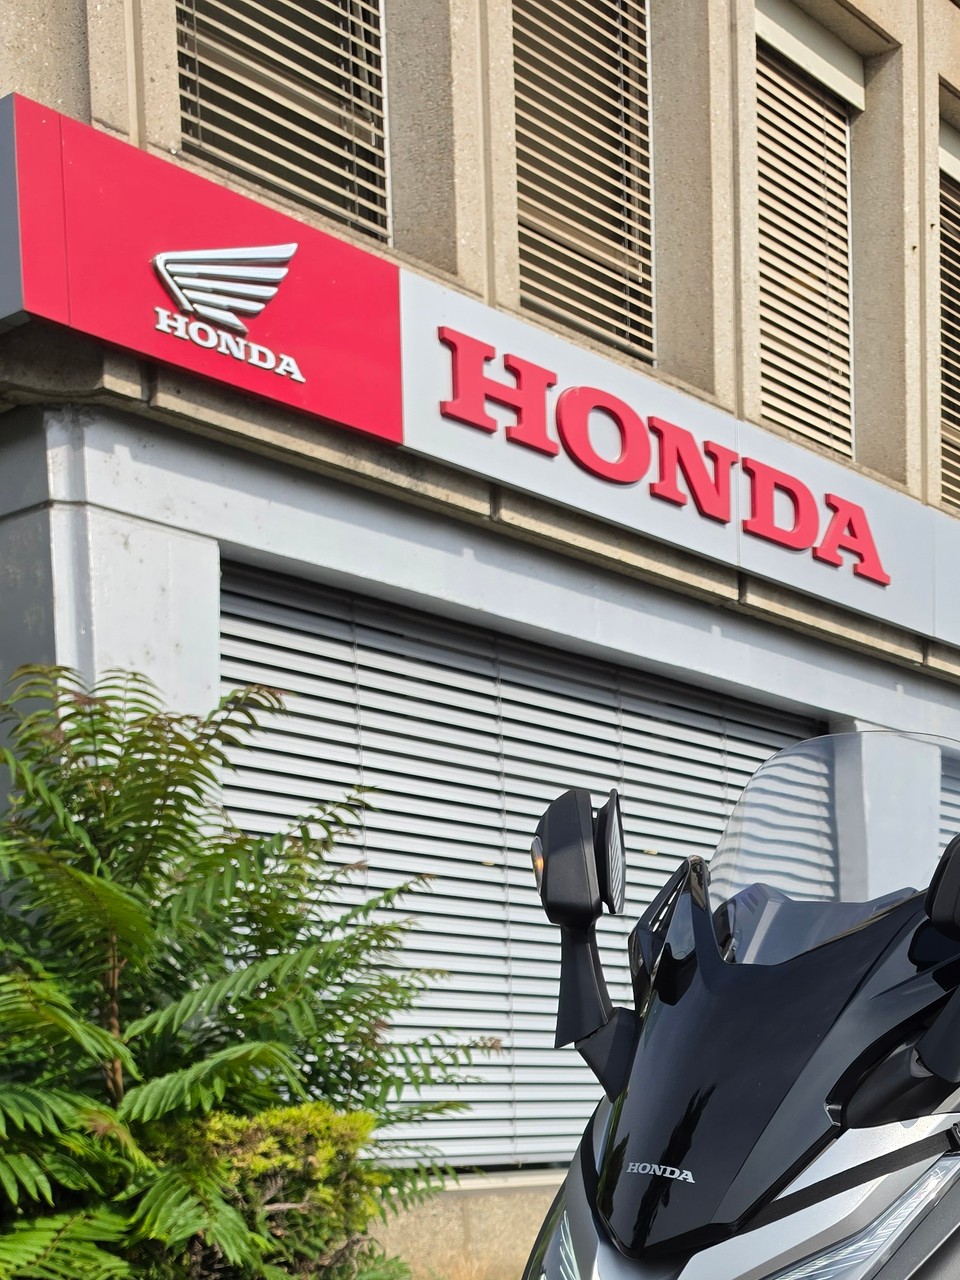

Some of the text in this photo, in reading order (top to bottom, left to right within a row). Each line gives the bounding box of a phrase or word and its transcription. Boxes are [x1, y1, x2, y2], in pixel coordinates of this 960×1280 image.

[154, 306, 306, 383] HONDA
[437, 325, 891, 587] HONDA
[626, 1162, 695, 1183] HONDA
